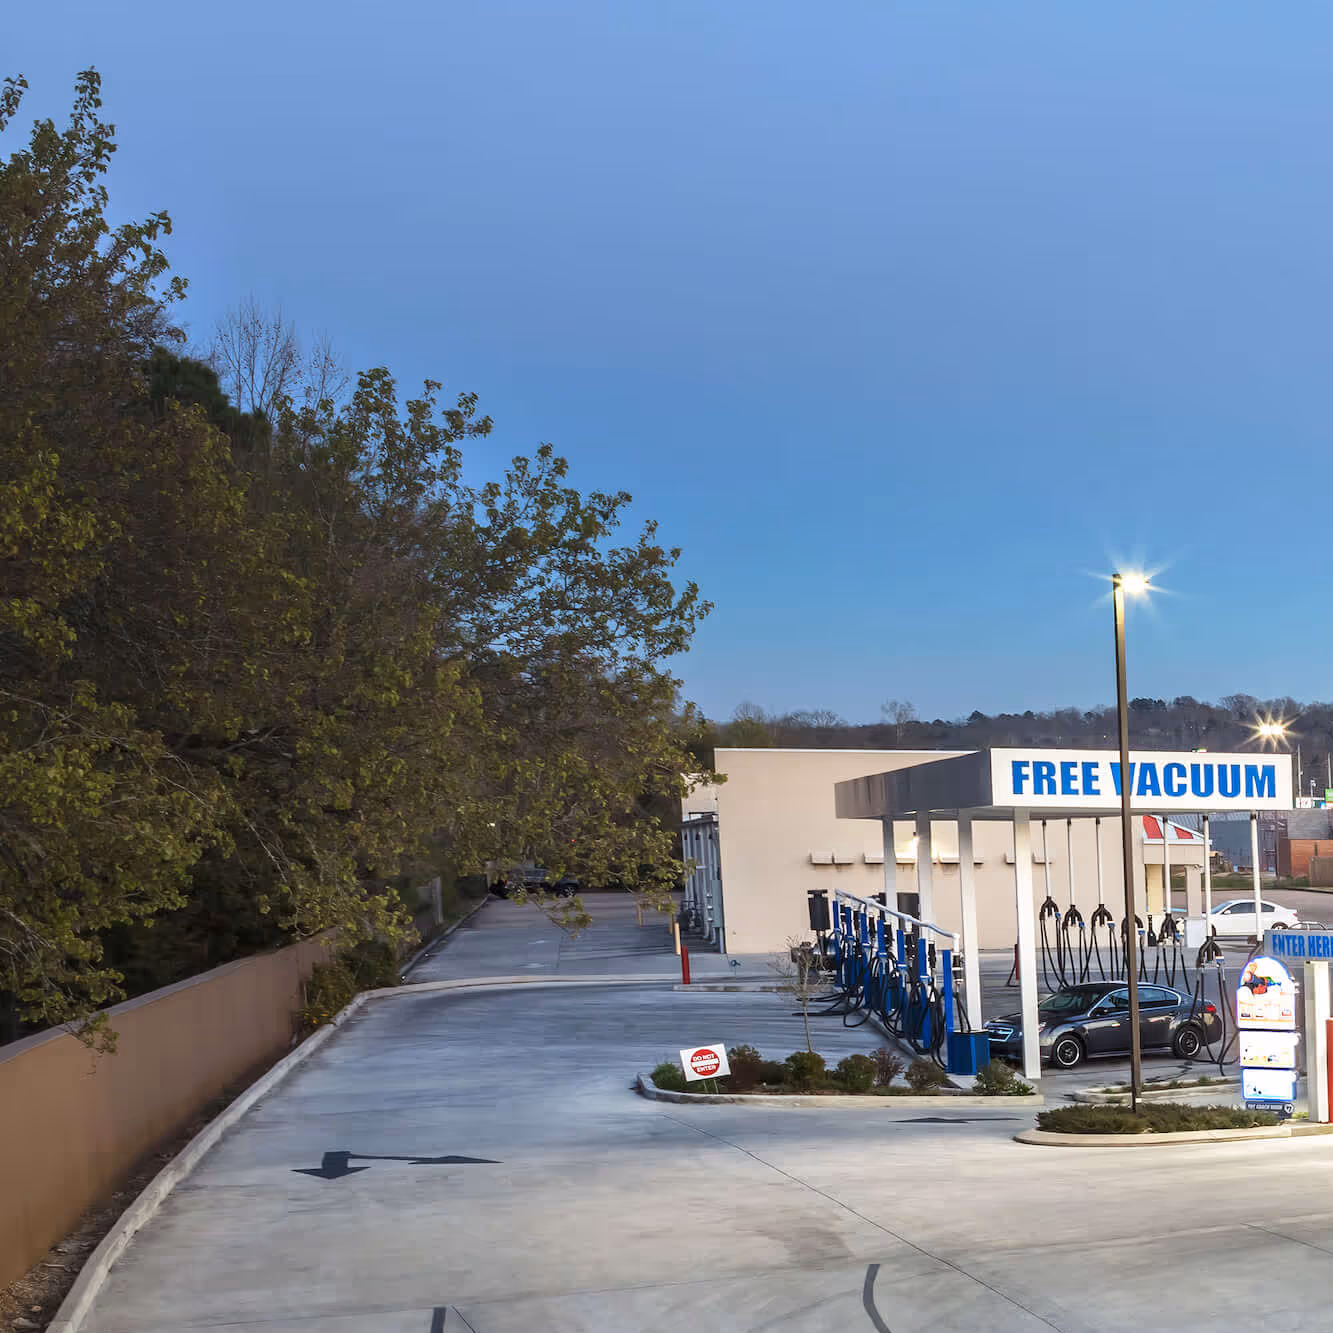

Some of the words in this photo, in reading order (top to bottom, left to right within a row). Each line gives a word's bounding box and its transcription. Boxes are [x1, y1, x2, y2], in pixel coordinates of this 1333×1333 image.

[1011, 760, 1100, 796] FREE
[1109, 761, 1276, 798] VACUUM
[1272, 935, 1305, 957] ENTER
[696, 1064, 717, 1072] ENTER
